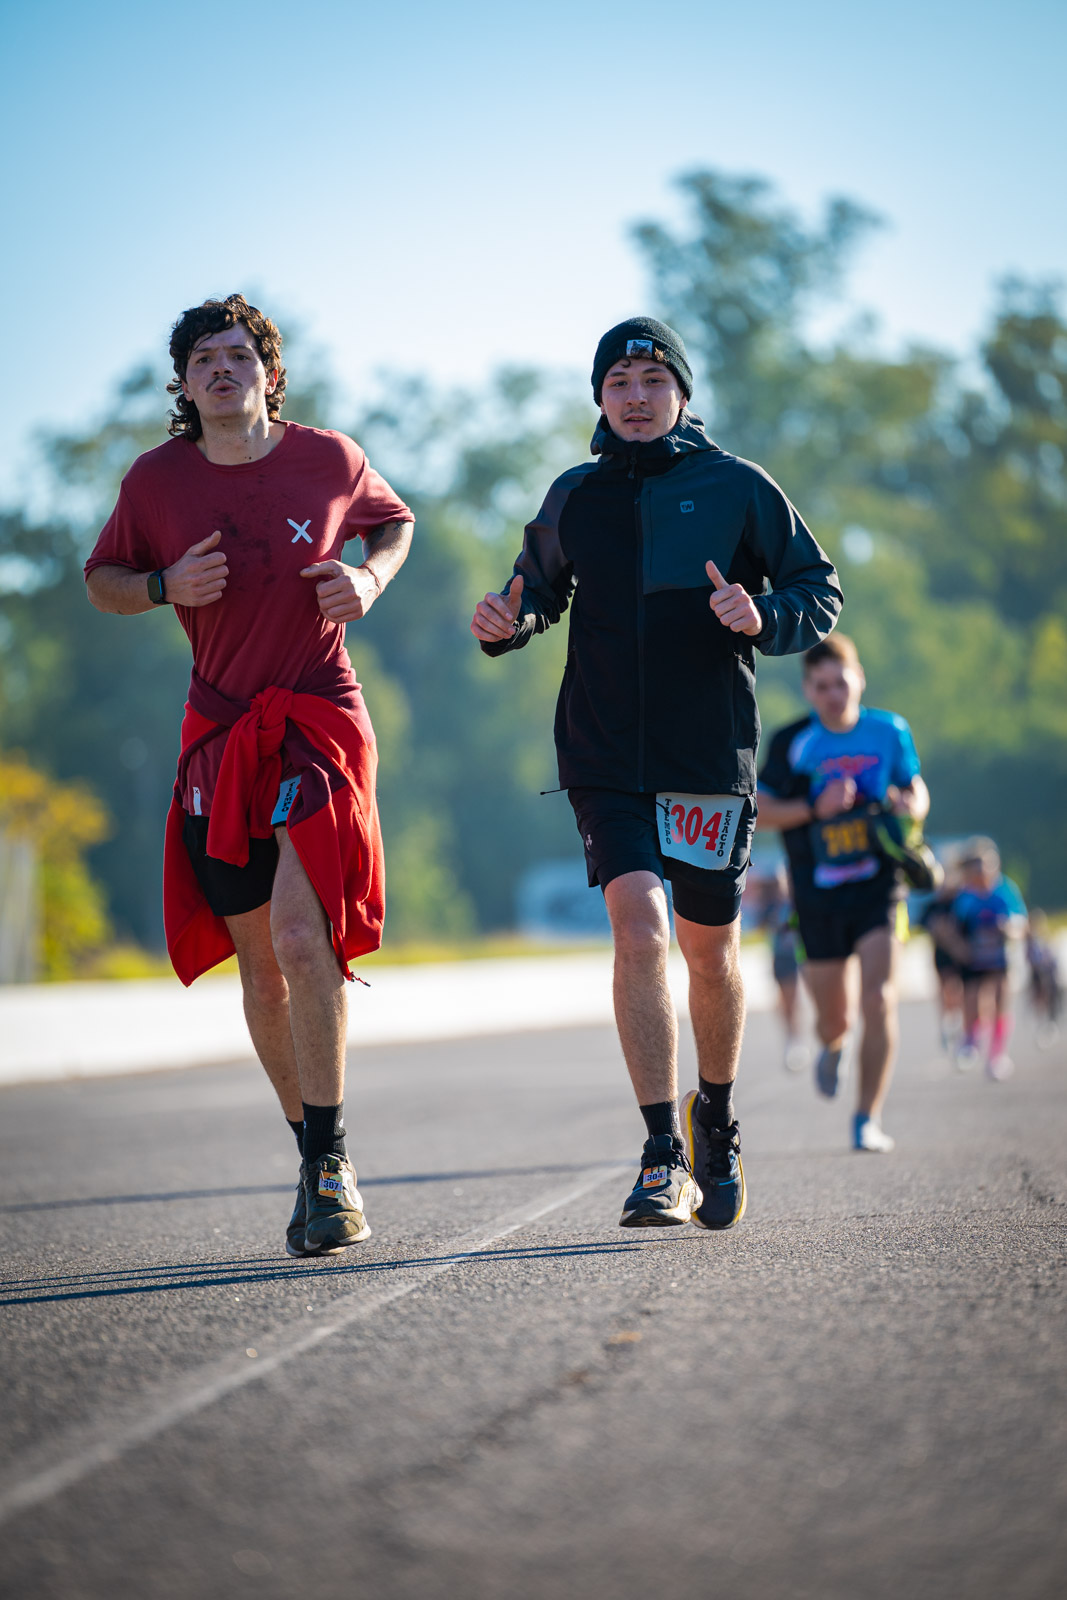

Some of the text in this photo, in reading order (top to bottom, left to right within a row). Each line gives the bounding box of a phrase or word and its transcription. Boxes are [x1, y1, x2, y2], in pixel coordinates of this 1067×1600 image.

[670, 804, 723, 851] 304
[717, 810, 733, 857] EXACTO
[323, 1180, 339, 1190] 307
[646, 1172, 663, 1181] 304
